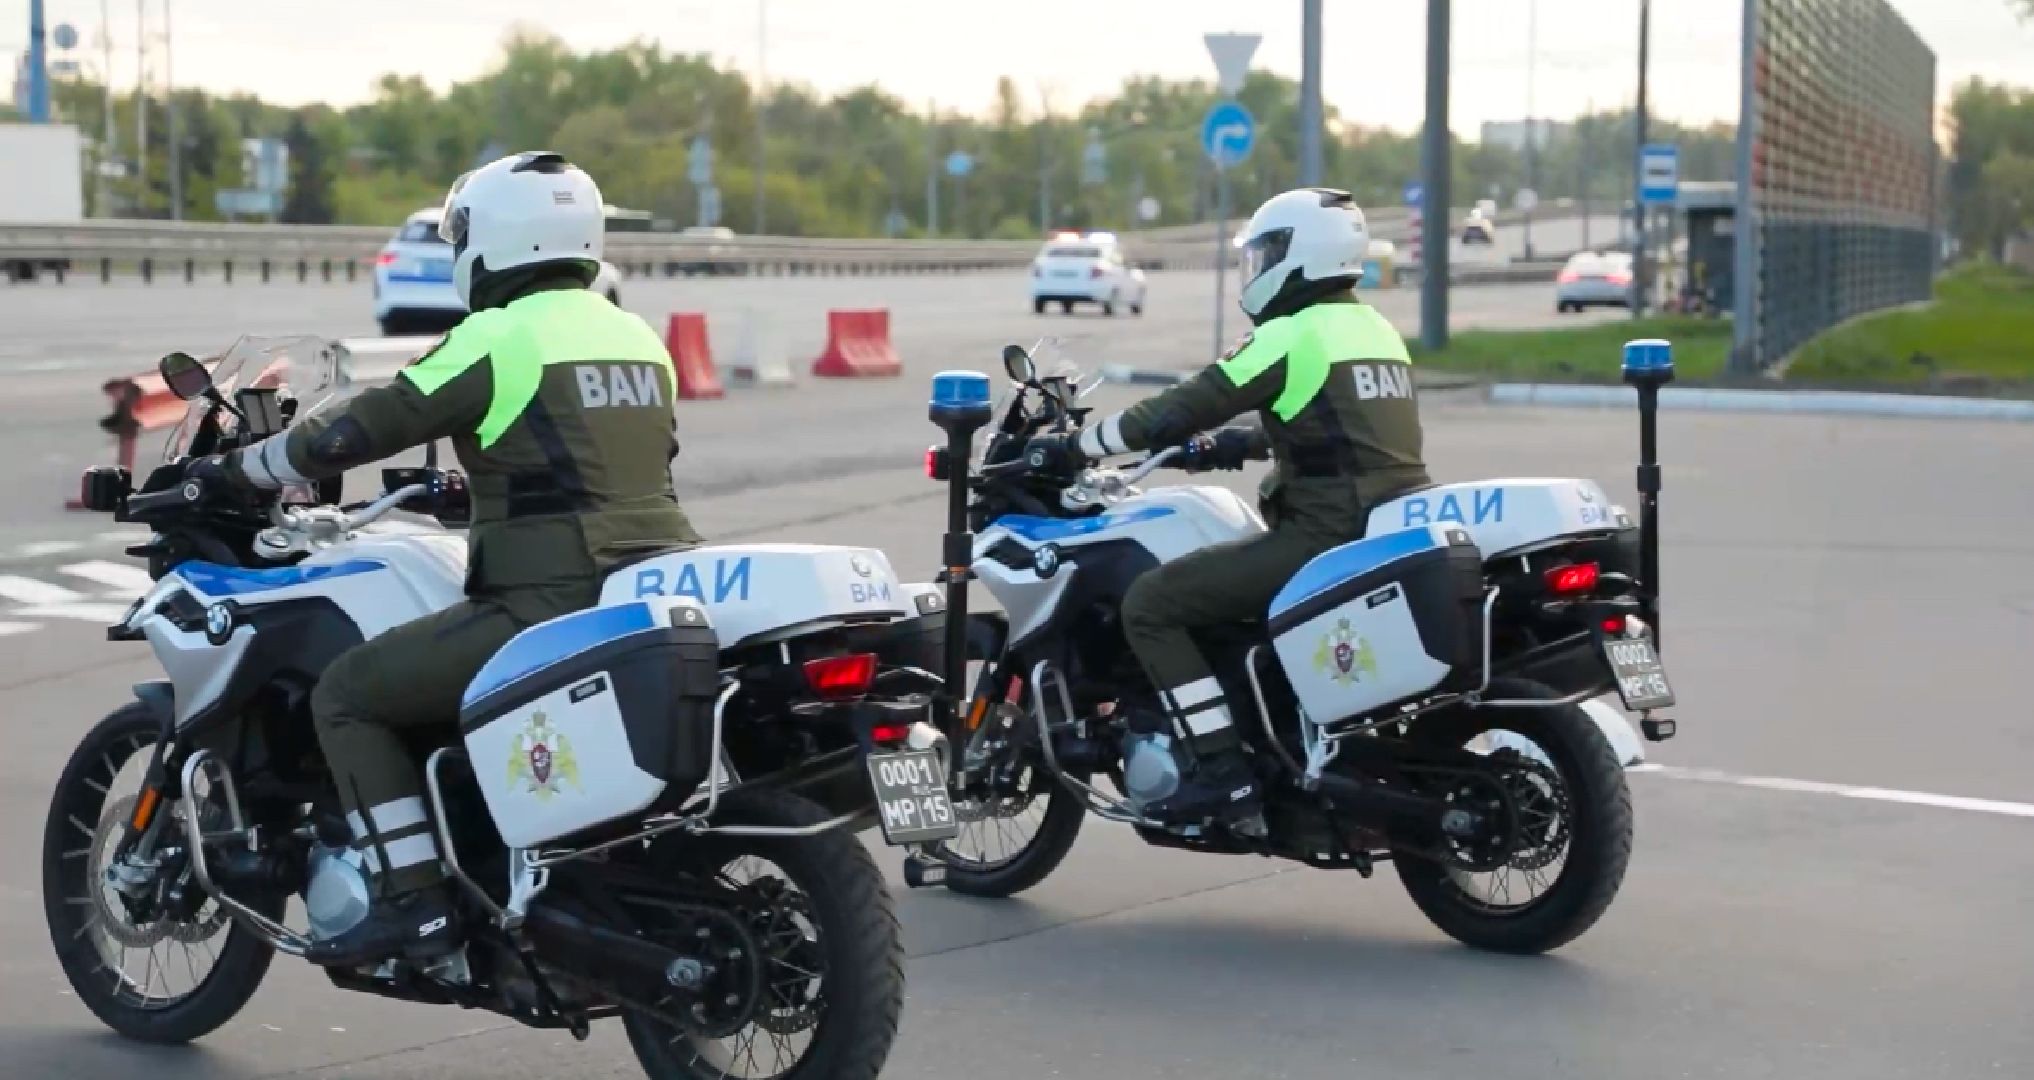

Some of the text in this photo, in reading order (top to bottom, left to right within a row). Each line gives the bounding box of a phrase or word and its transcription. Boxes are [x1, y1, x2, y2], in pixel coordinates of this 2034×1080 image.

[575, 365, 664, 408] ВАИ
[1352, 364, 1412, 400] ВАИ
[1404, 487, 1504, 527] ВАИ
[636, 556, 752, 605] ВАИ
[850, 582, 891, 603] ВАИ
[879, 758, 933, 786] 0001
[884, 796, 949, 826] МР 15
